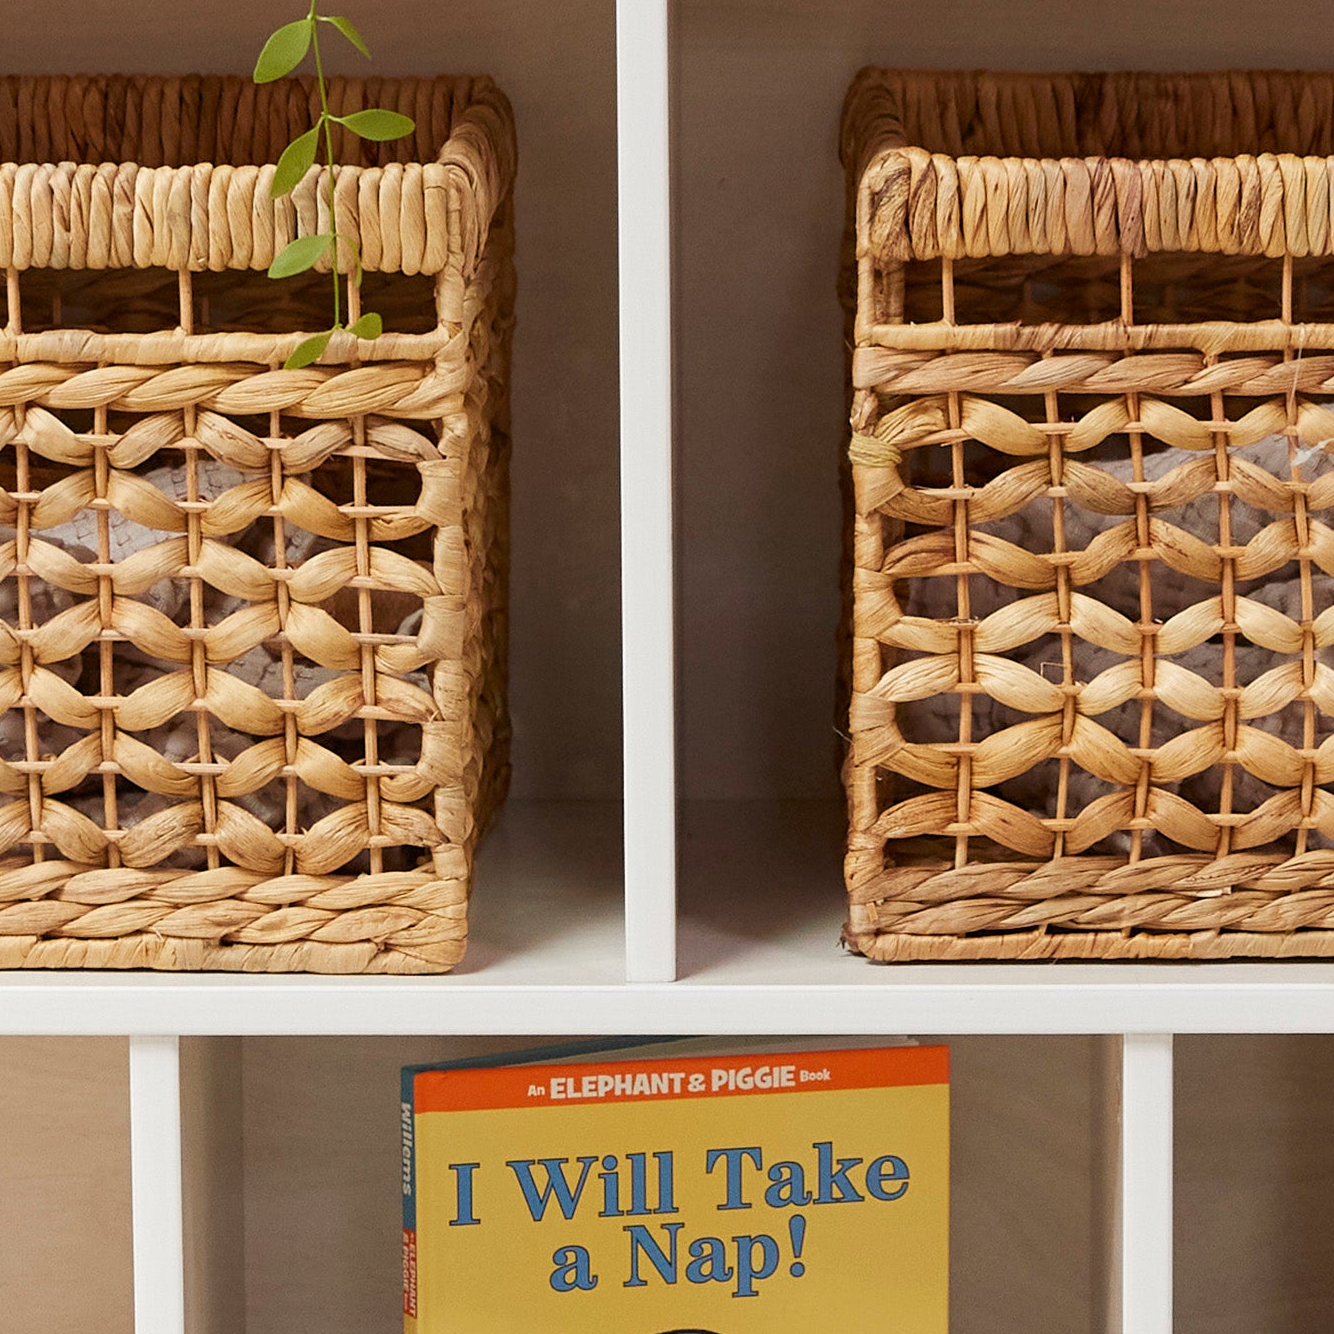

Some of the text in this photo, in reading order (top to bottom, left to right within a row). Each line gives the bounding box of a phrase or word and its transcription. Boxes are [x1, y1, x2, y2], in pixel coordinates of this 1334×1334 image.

[527, 1065, 831, 1100] An ELEPHANT & PIGGIE Book
[448, 1141, 911, 1227] I Will Take
[549, 1213, 808, 1298] a Nap!
